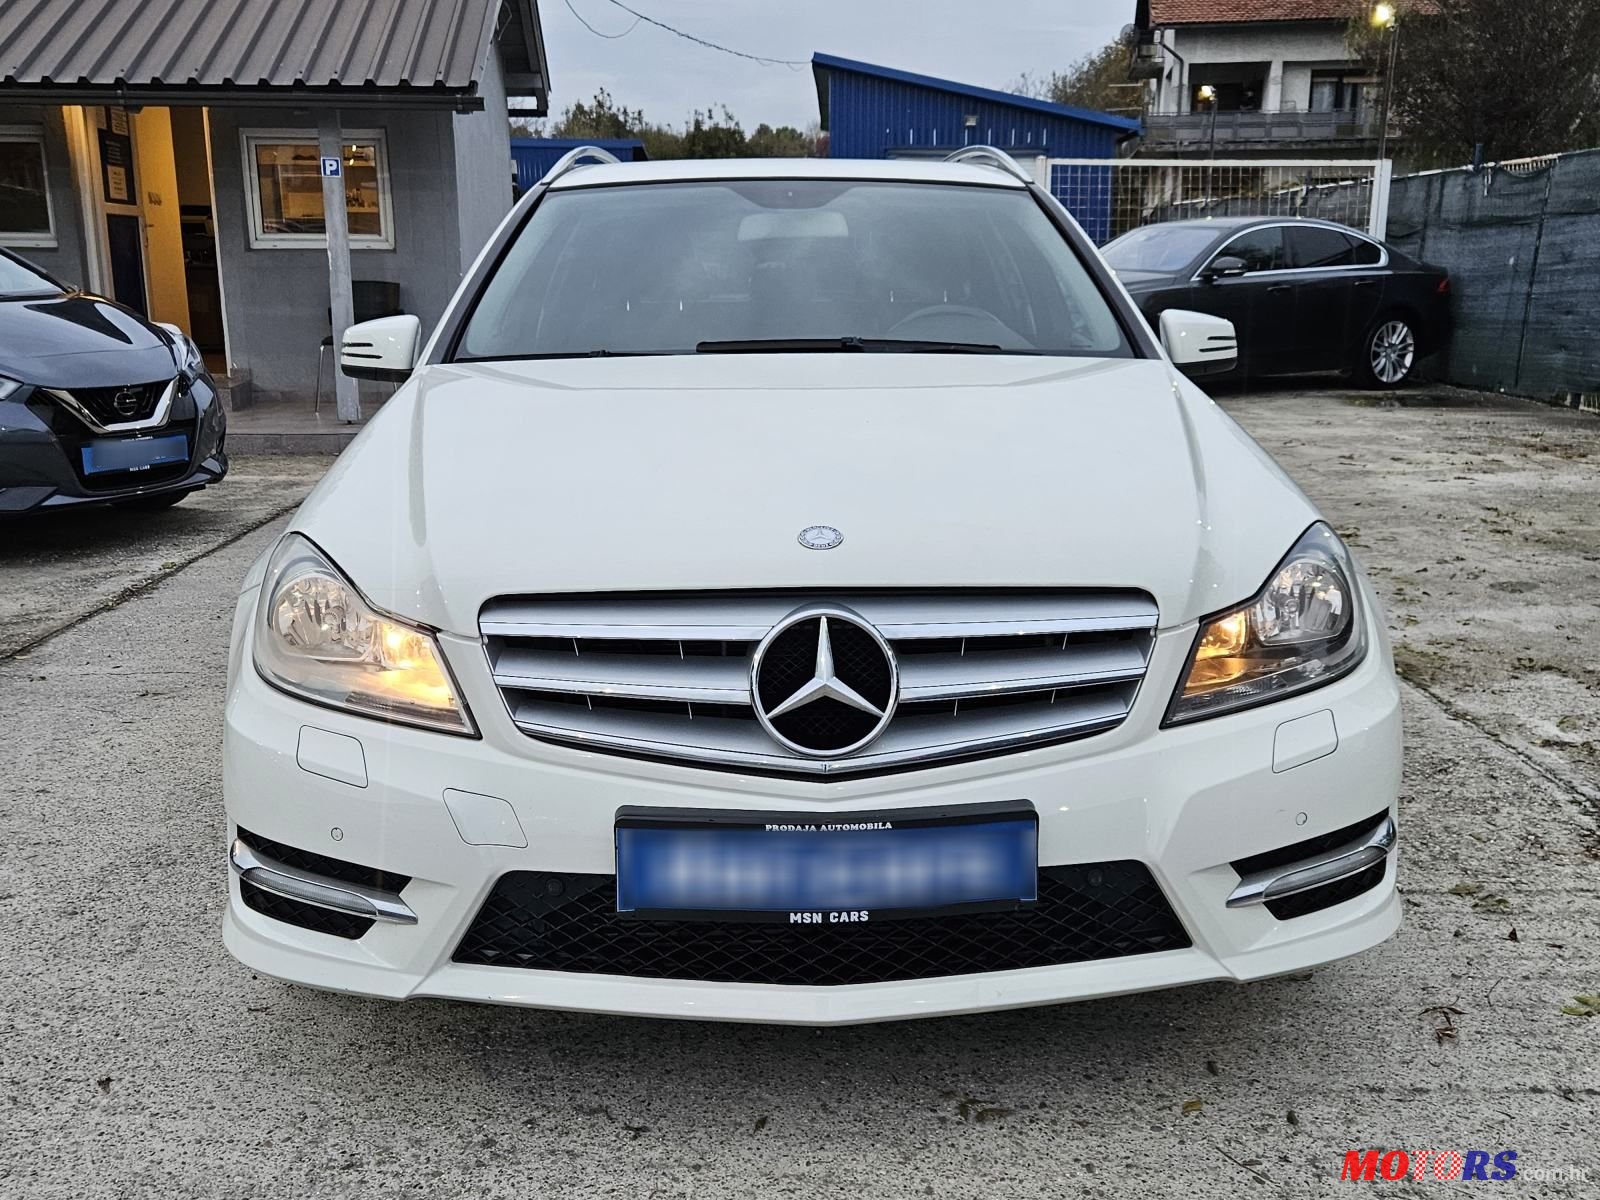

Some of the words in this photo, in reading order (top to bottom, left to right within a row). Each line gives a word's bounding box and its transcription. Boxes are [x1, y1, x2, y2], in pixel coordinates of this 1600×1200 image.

[325, 160, 337, 176] P
[765, 823, 816, 833] PRODAJA
[820, 822, 893, 832] AUTOMOBILA
[789, 912, 822, 924] MSN
[829, 911, 869, 923] CARS
